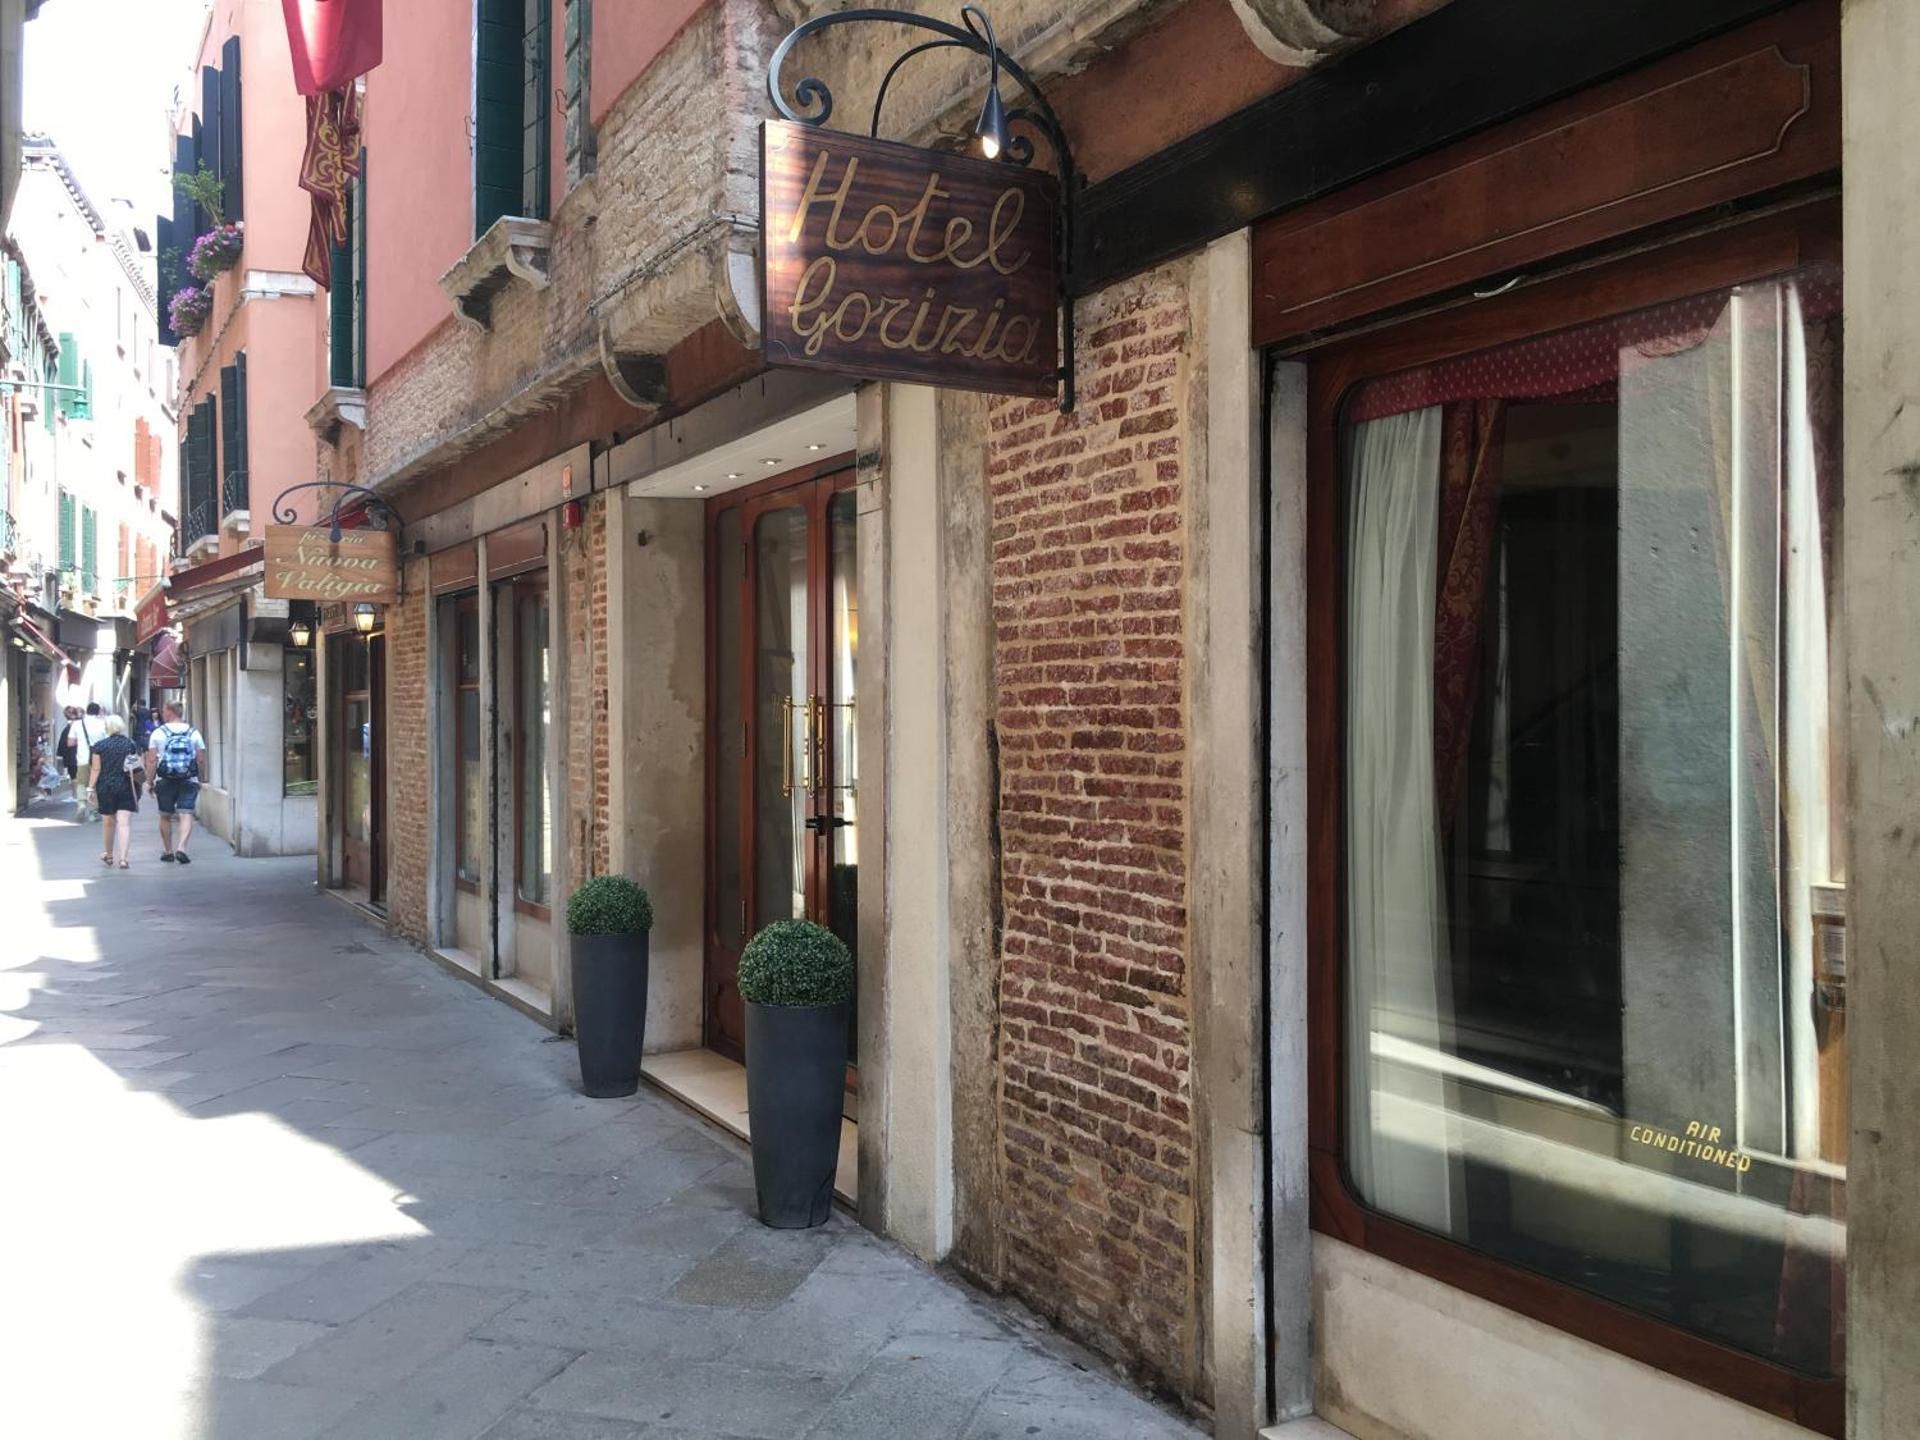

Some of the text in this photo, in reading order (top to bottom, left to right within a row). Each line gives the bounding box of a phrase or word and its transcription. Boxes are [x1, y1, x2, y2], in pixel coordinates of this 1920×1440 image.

[789, 150, 1031, 274] Hotel
[788, 256, 1040, 364] Gorizia
[275, 571, 385, 598] Valigia
[1630, 1126, 1751, 1172] CONDITIONED
[1686, 1121, 1721, 1143] AIR
